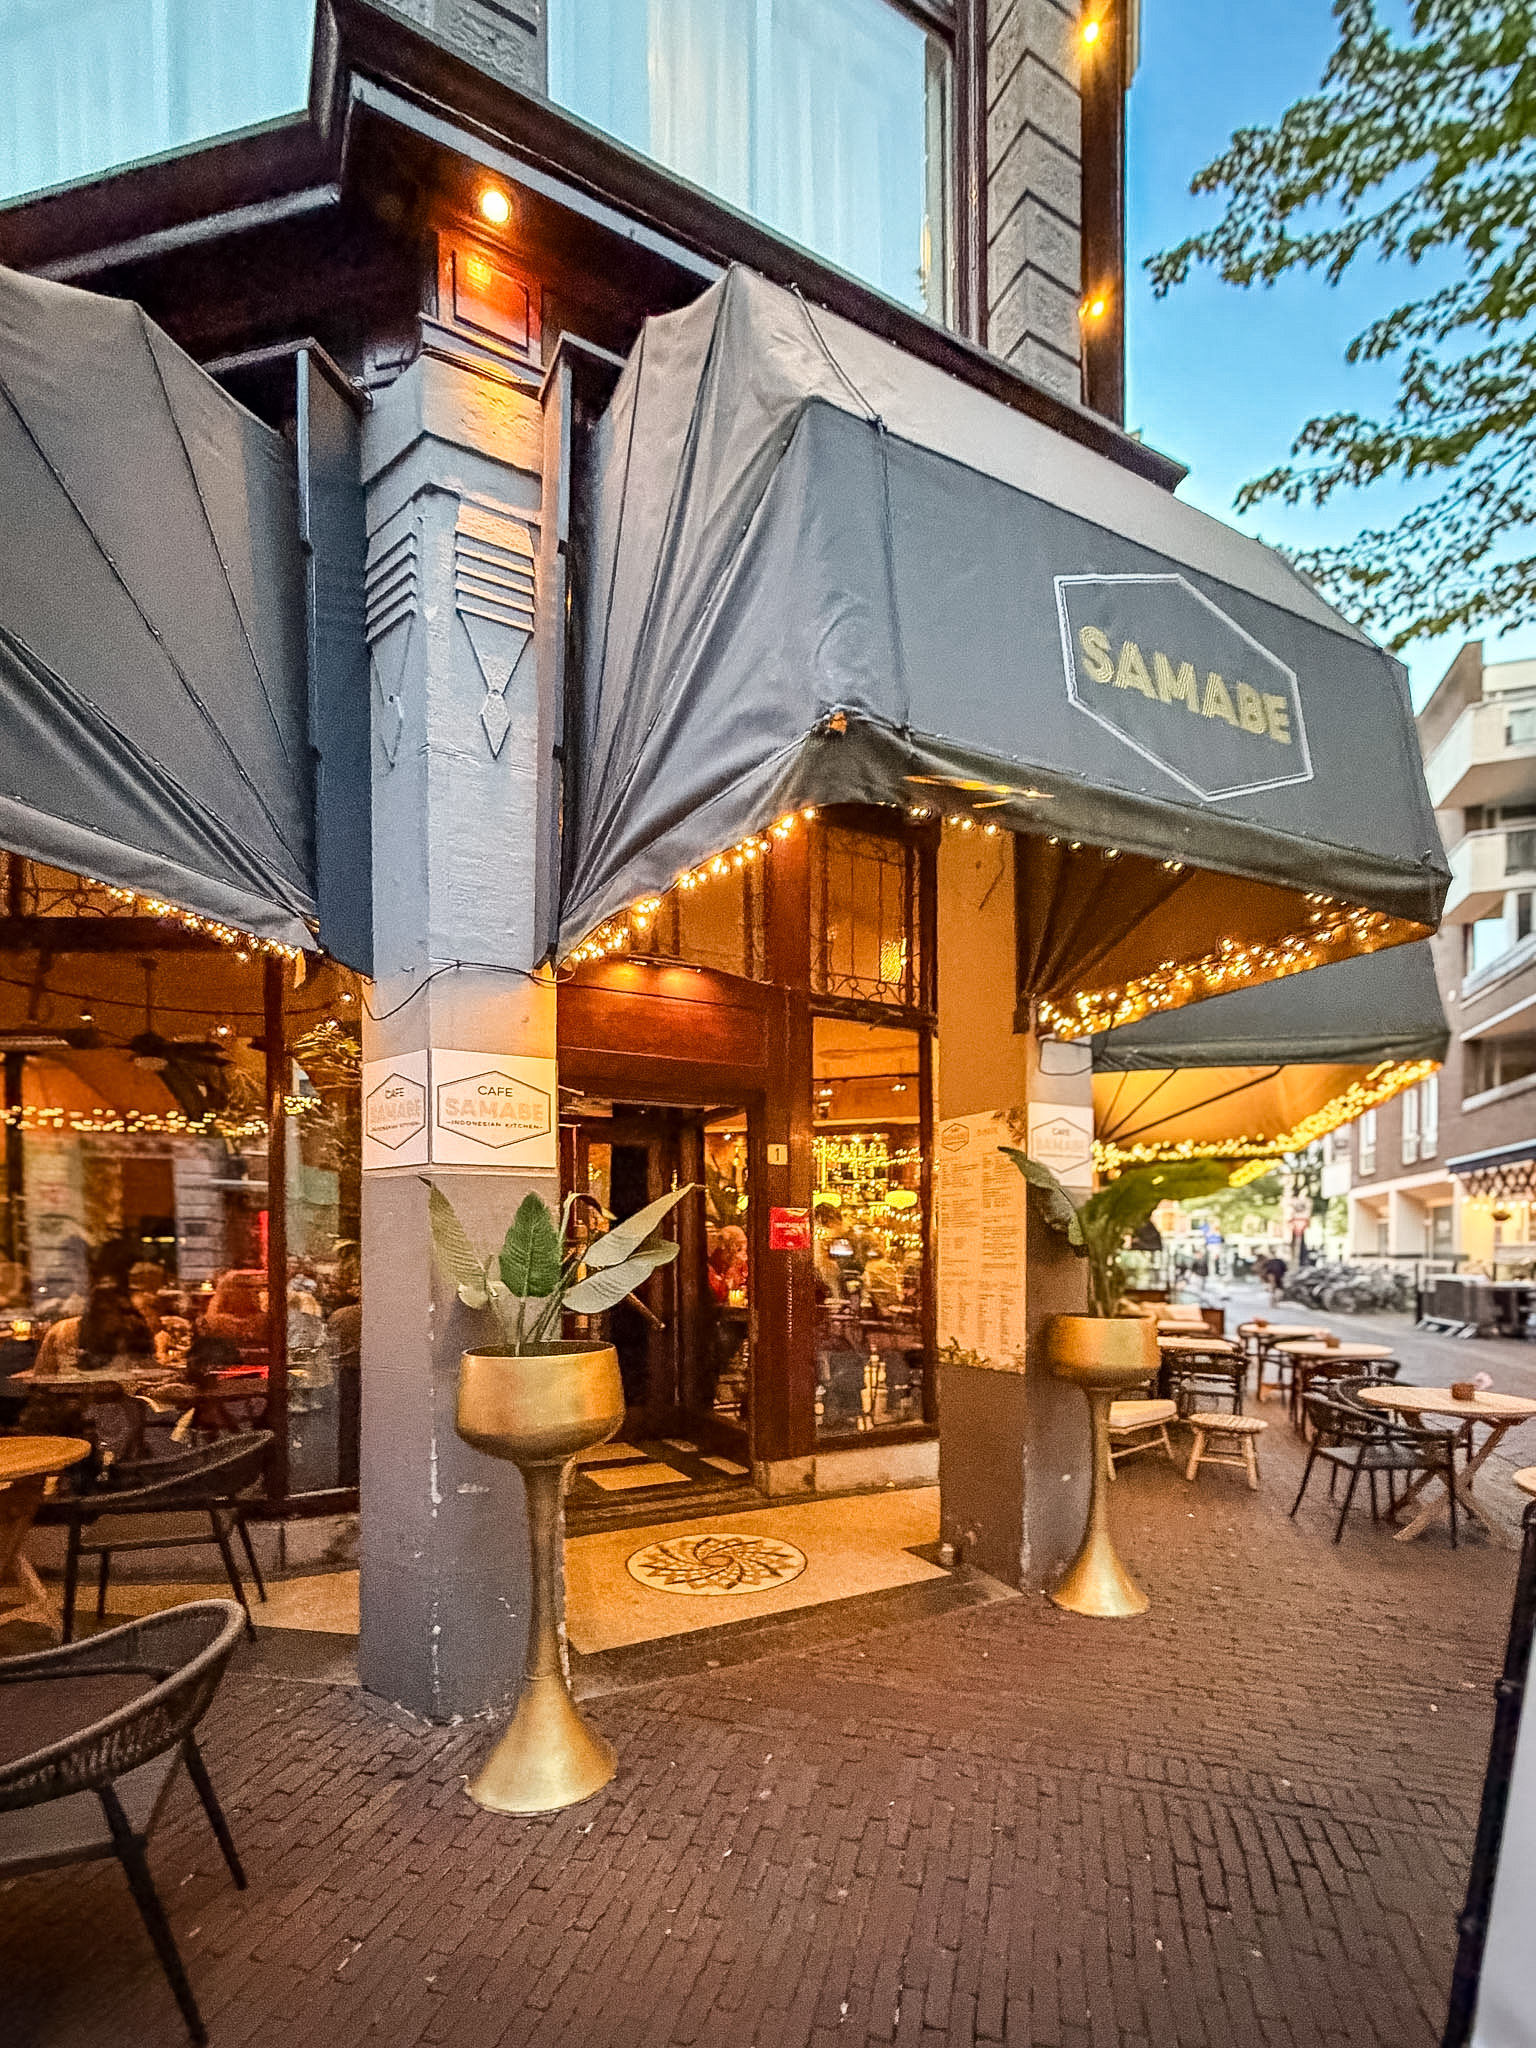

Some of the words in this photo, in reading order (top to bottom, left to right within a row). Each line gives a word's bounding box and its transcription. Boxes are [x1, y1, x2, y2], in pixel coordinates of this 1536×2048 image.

[1078, 625, 1293, 745] SAMABE
[477, 1085, 514, 1098] CAFE
[445, 1097, 544, 1122] SAMABE
[451, 1119, 502, 1127] INDONESIAN
